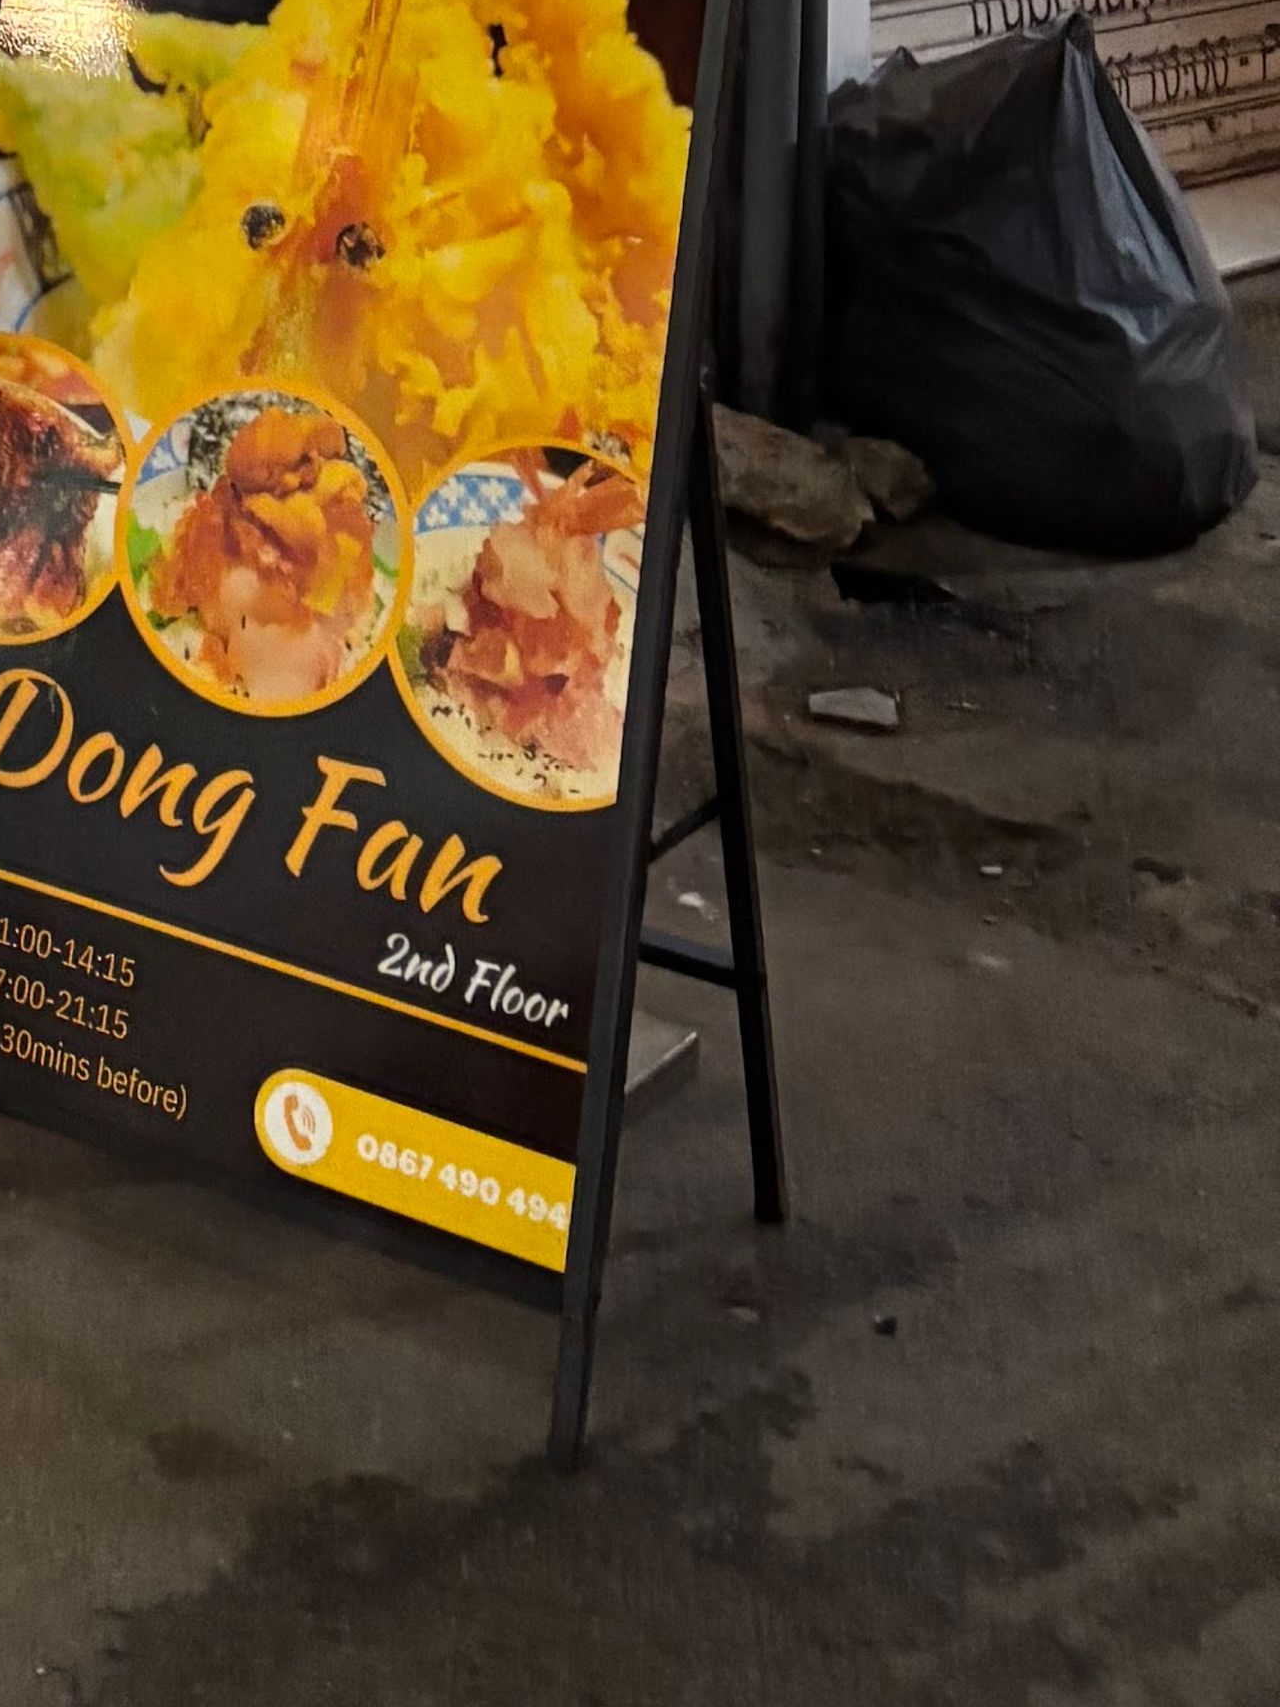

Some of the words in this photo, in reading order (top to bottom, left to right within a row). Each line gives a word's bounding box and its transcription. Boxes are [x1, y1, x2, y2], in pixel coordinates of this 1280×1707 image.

[284, 754, 509, 925] Fan
[377, 932, 456, 993] 2nd
[464, 958, 570, 1028] Floor
[0, 1024, 90, 1083] 30mins
[96, 1057, 189, 1121] before)
[356, 1134, 434, 1181] 0867
[439, 1163, 501, 1206] 490
[507, 1188, 569, 1232] 494
